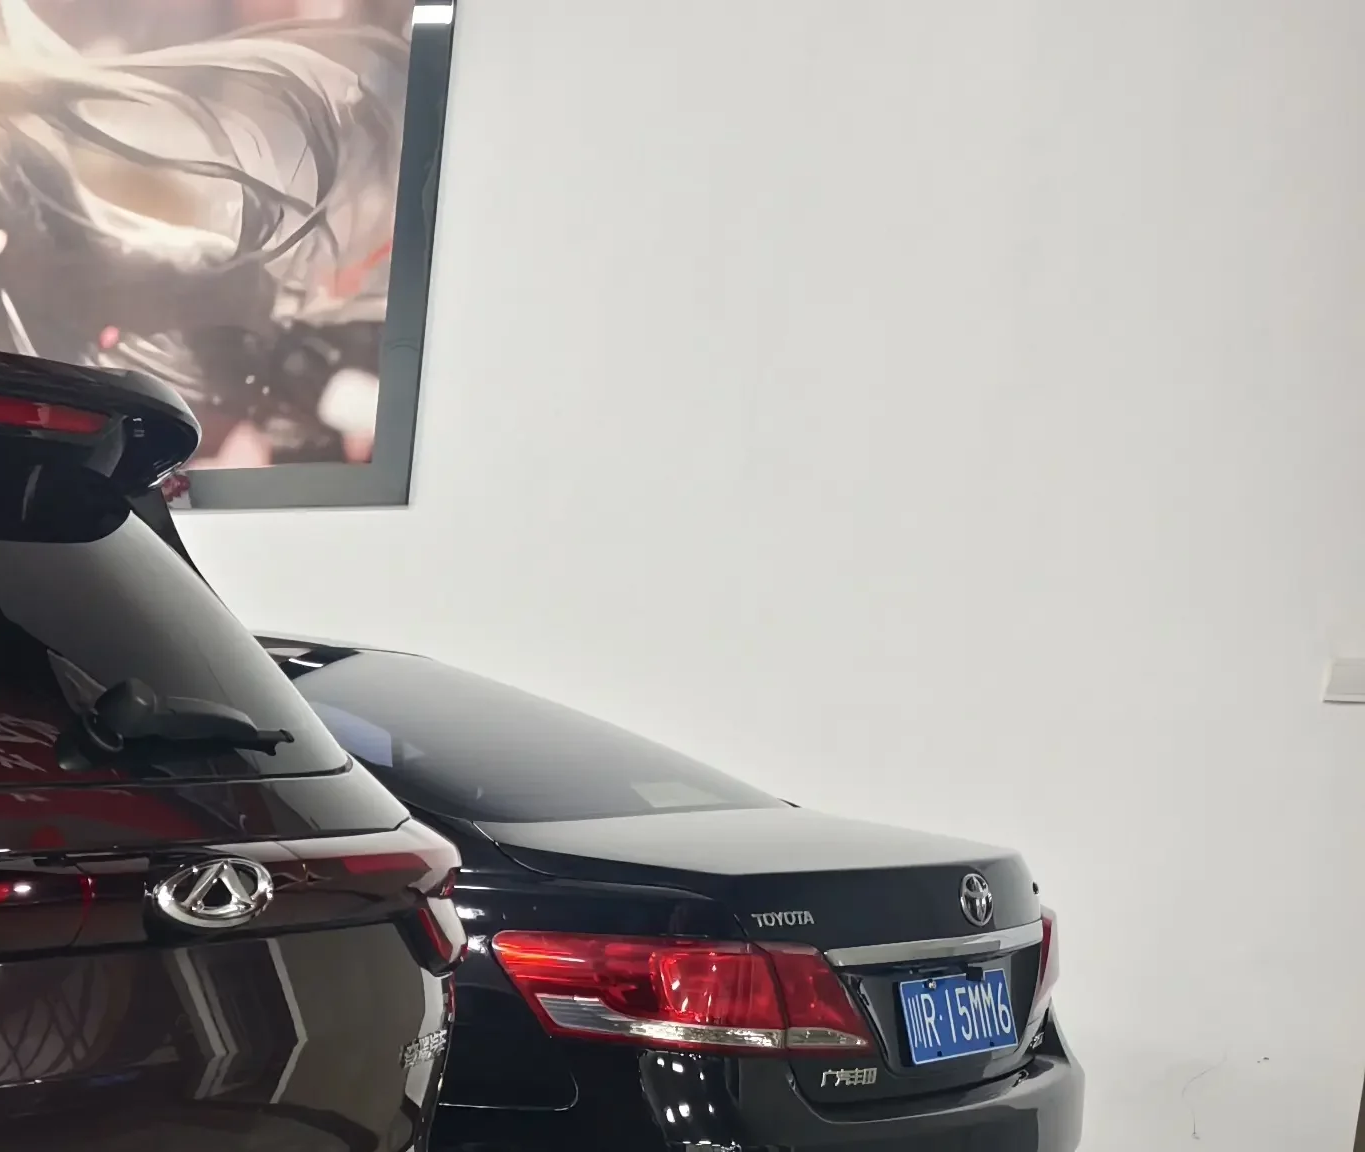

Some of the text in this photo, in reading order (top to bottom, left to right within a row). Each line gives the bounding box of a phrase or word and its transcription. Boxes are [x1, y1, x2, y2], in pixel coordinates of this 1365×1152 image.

[751, 910, 815, 928] TOYOTA
[820, 1067, 878, 1088] 广汽丰田
